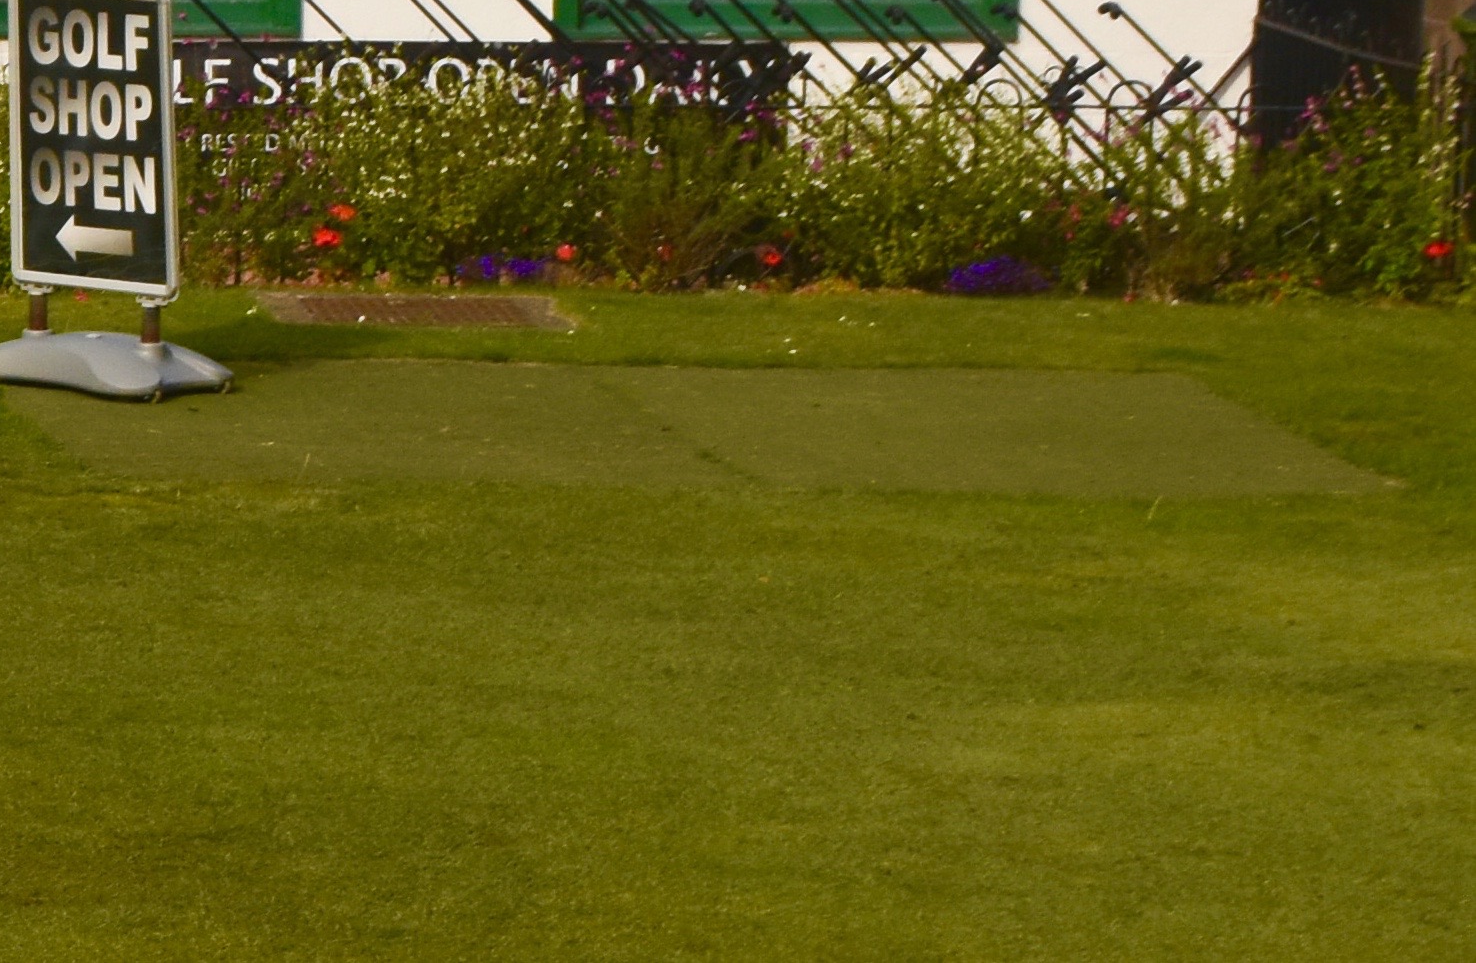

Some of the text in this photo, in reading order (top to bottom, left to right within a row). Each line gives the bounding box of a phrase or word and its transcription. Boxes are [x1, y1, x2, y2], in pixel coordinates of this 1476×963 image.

[28, 7, 151, 72] GOLF
[28, 75, 153, 142] SHOP
[252, 56, 407, 106] SHOP
[29, 147, 158, 215] OPEN
